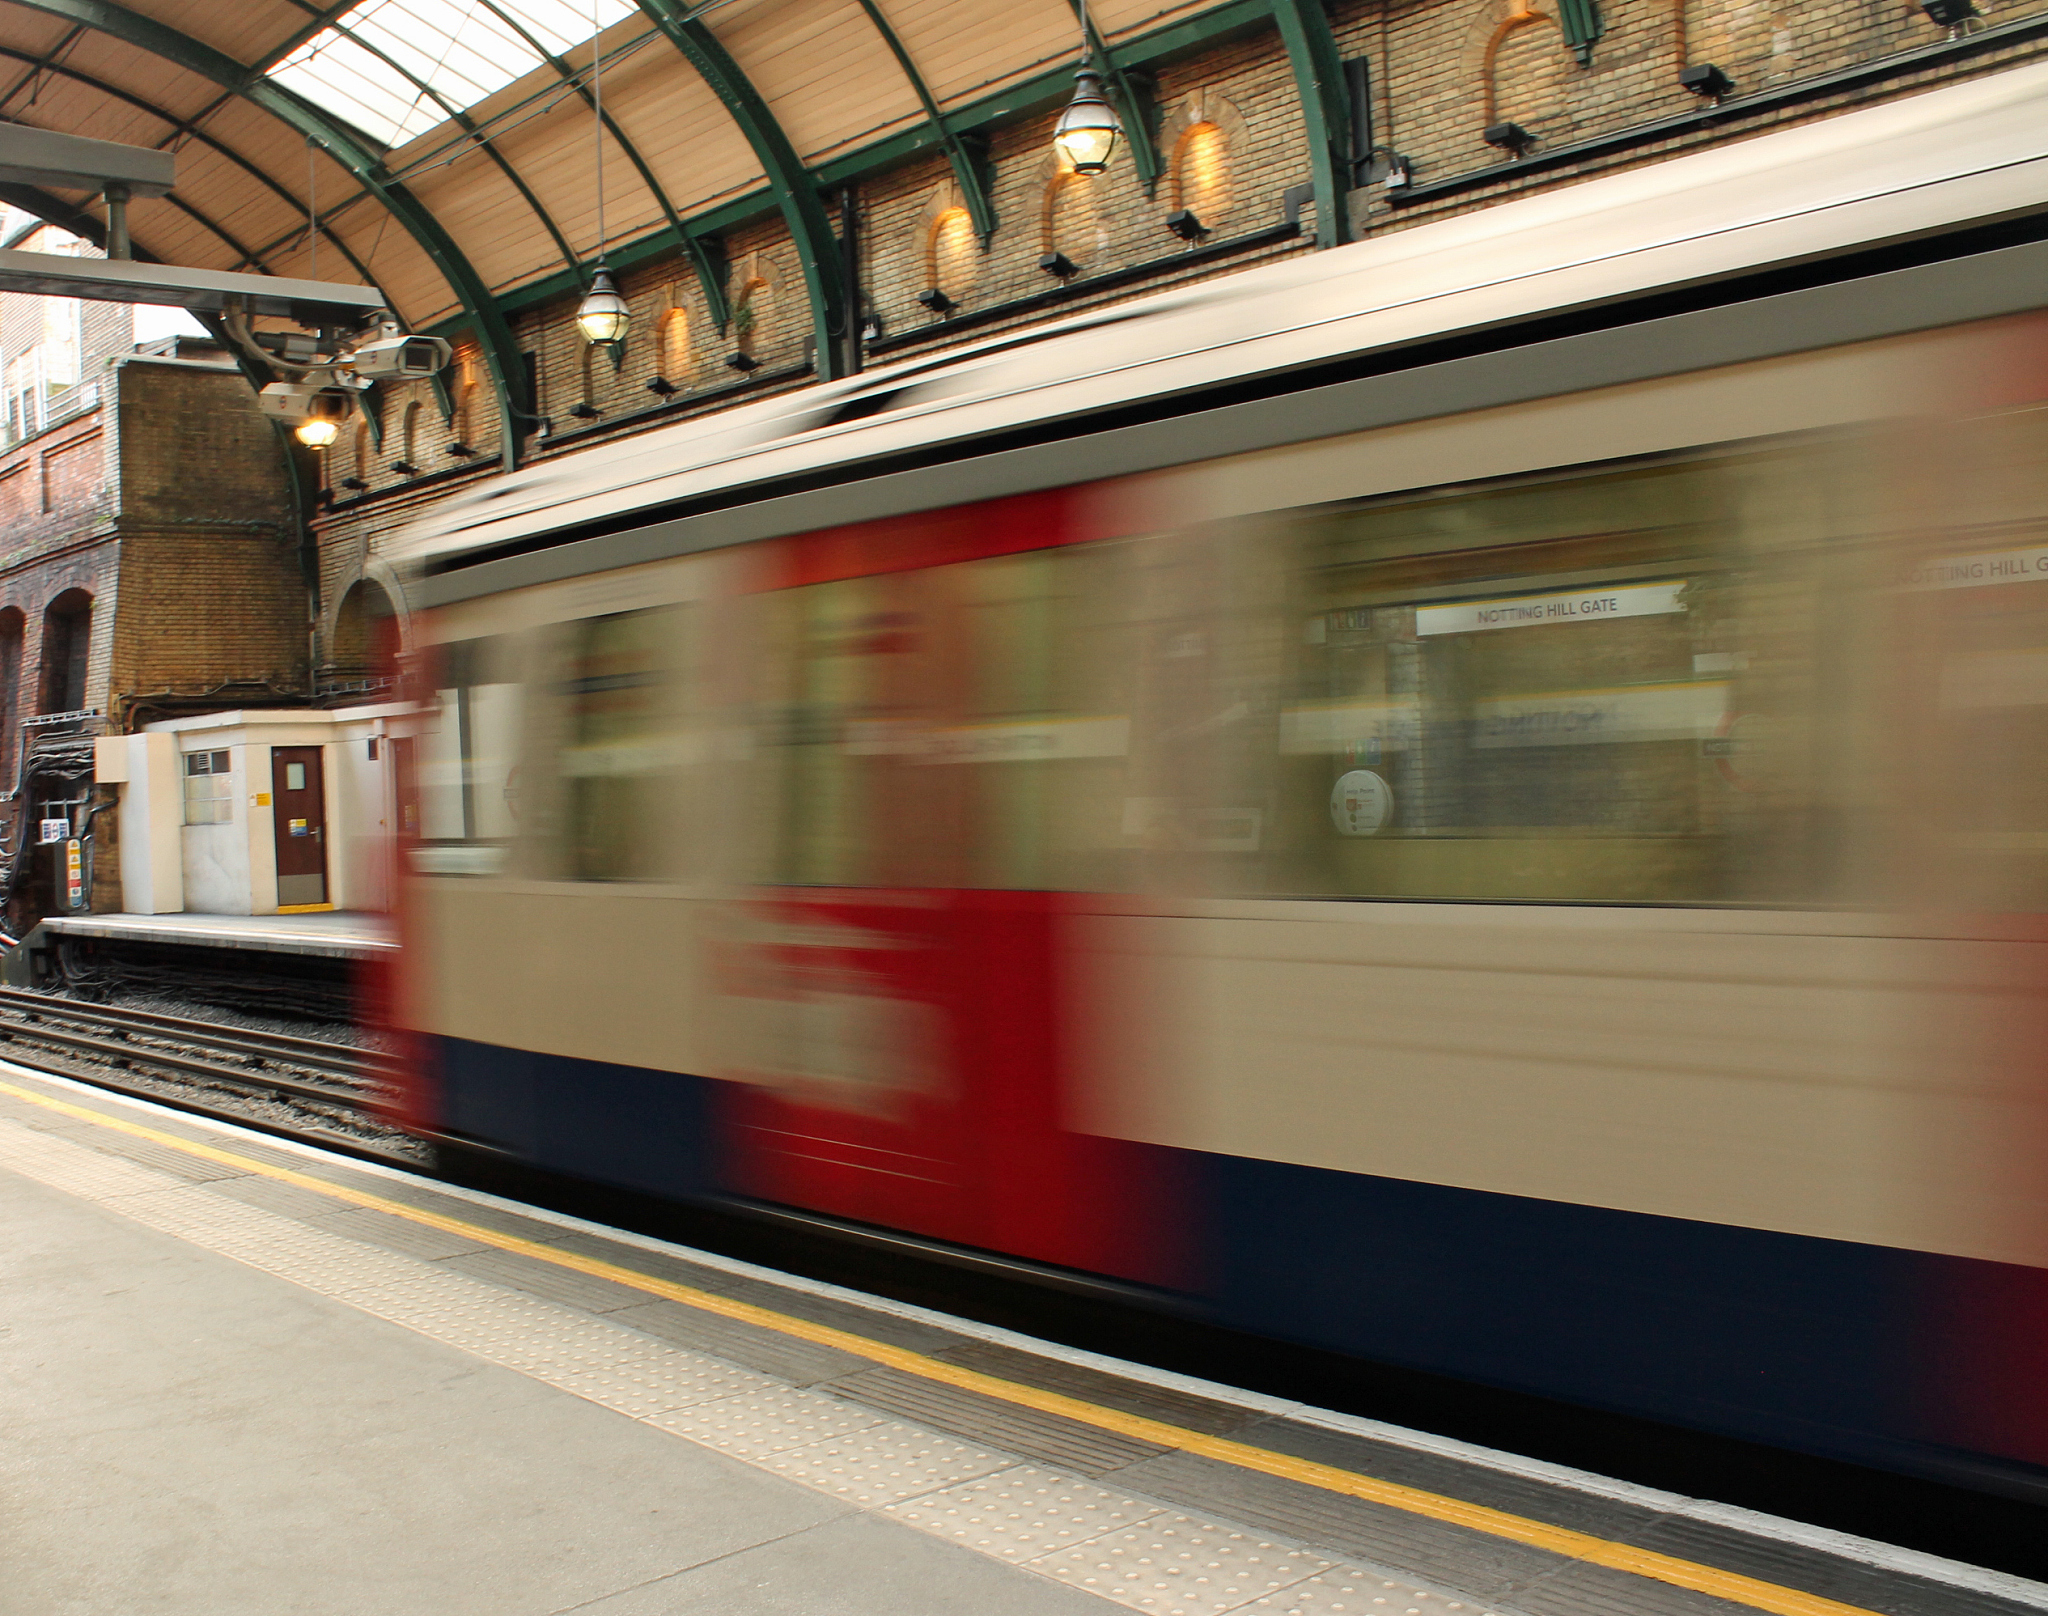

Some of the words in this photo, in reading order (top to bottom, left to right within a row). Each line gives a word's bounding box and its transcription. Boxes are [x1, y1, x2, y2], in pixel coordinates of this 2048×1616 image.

[1989, 560, 2030, 577] HILL
[1477, 605, 1543, 623] NOTTING
[1546, 602, 1577, 617] HILL
[1580, 598, 1617, 614] GATE
